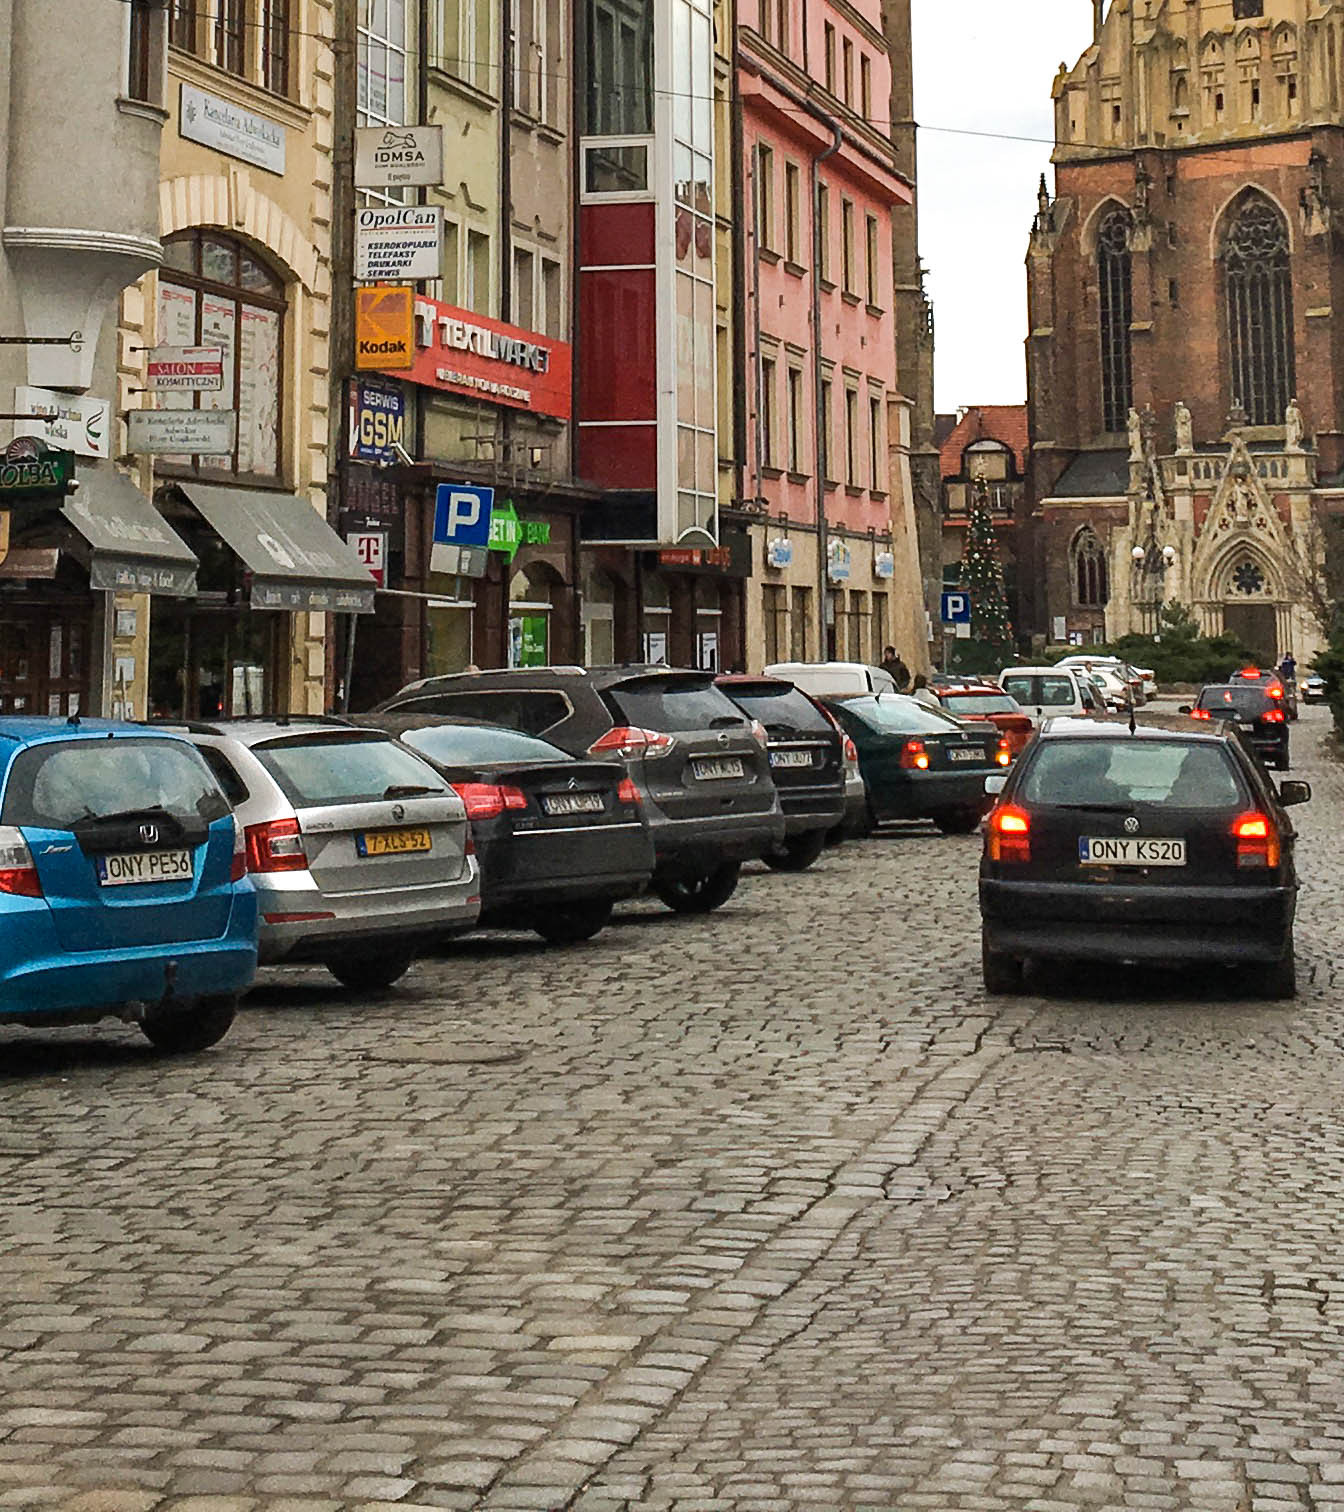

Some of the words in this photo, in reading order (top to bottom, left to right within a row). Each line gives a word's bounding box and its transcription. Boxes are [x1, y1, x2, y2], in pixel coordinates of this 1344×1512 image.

[375, 151, 424, 163] IDMSA
[360, 209, 436, 230] OpolCan
[368, 241, 437, 250] KSEROKOPIARKI
[367, 269, 400, 277] SERWIS
[359, 340, 406, 354] Kodak
[438, 316, 552, 374] TEXTILMARKET
[157, 363, 196, 375] SALON
[363, 390, 399, 410] SERWIS
[360, 409, 404, 448] GSM
[447, 492, 481, 537] P
[948, 596, 964, 619] P
[368, 832, 426, 852] 7-XLS-52
[1092, 841, 1130, 859] ONY
[1136, 842, 1182, 860] KS20
[109, 855, 143, 878] ONY
[148, 852, 189, 875] PE56
